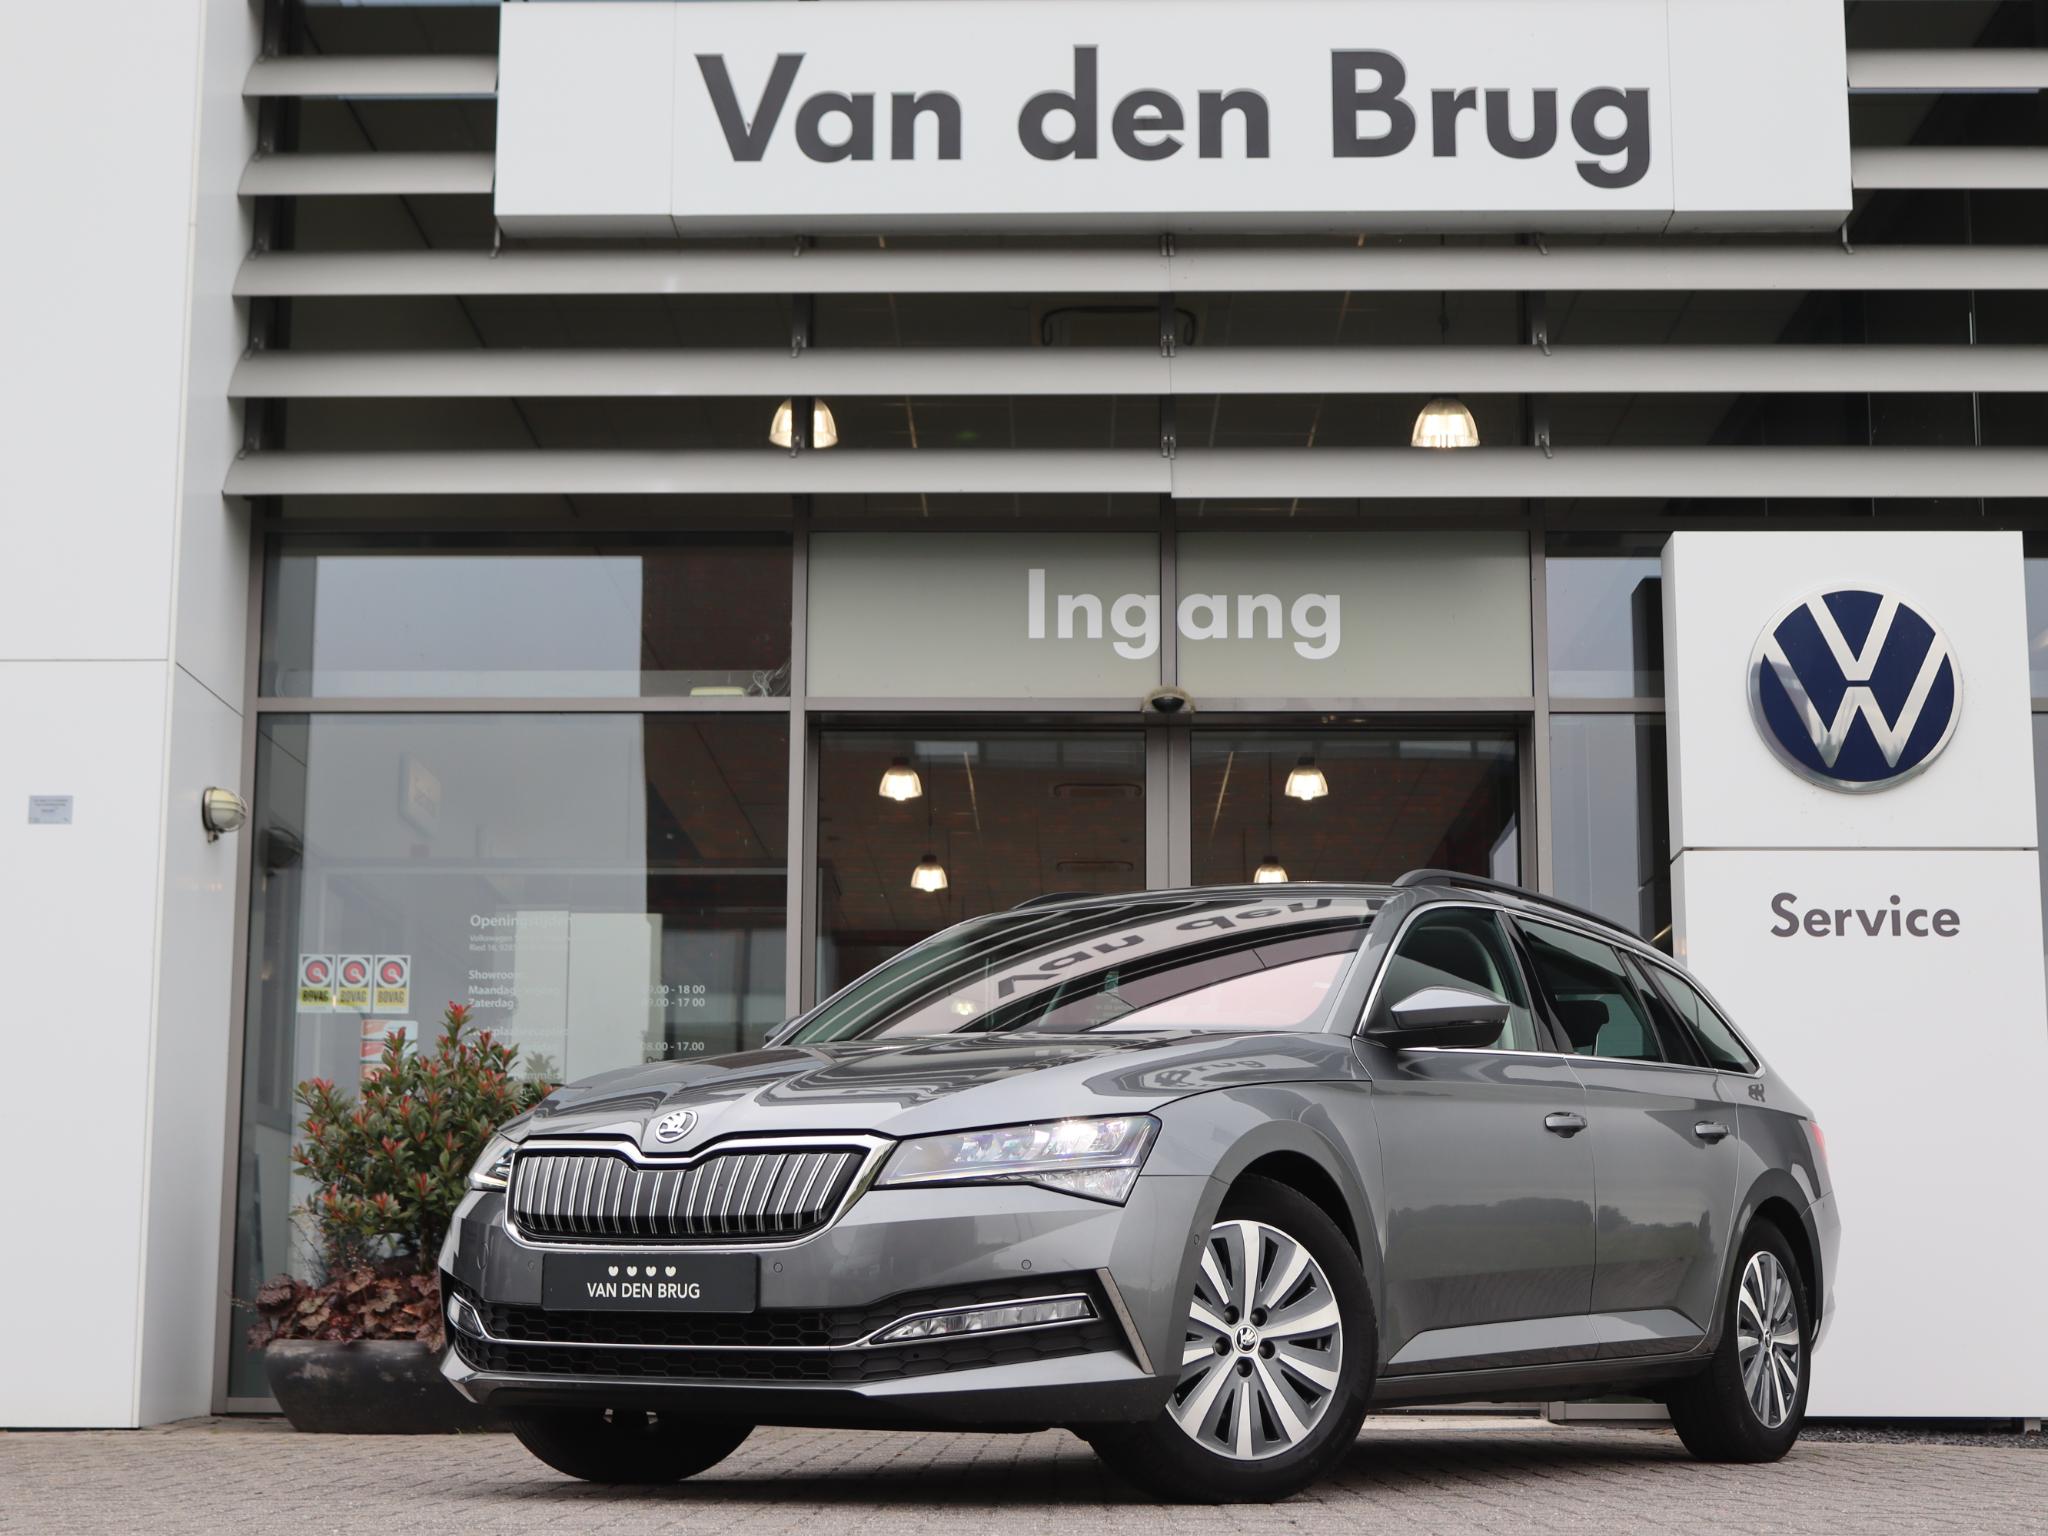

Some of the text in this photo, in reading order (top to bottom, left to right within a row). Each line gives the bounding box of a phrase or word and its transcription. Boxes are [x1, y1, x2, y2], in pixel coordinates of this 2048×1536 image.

[694, 44, 1651, 189] Van den Brug
[1028, 568, 1341, 659] Ingang
[1770, 892, 1961, 938] Service
[587, 1282, 701, 1299] VAN DEN BRUG
